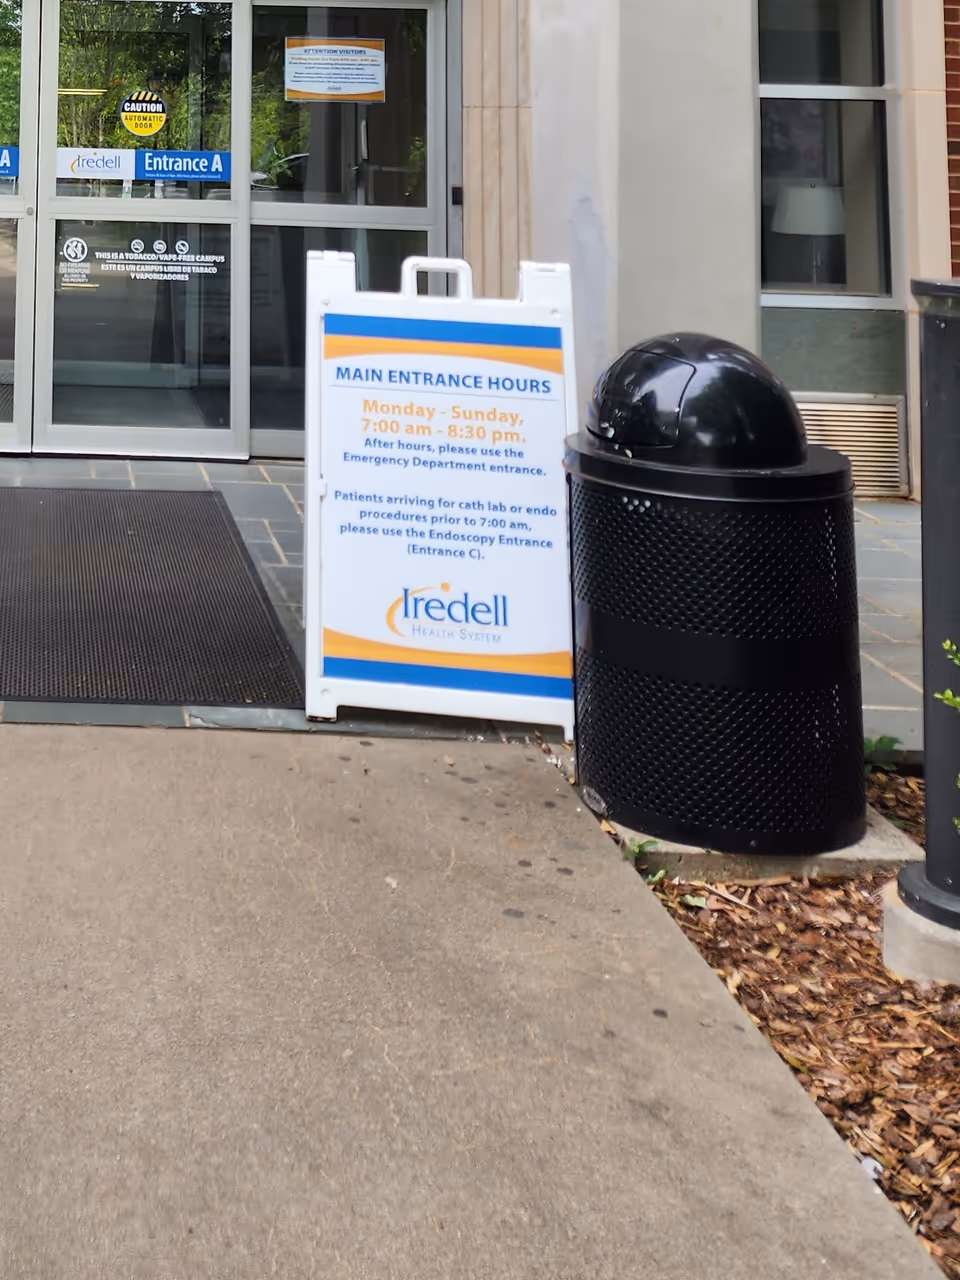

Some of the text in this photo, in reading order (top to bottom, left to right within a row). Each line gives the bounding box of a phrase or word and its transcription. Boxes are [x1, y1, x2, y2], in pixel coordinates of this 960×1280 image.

[124, 102, 163, 112] CAUTION
[0, 149, 11, 168] A
[77, 154, 121, 169] Iredell
[144, 152, 223, 172] Entrance A
[94, 251, 110, 259] THIS
[111, 252, 118, 260] IS
[119, 252, 125, 260] A
[195, 254, 225, 263] CAMPUS
[135, 272, 190, 281] VAPORIZADORES
[136, 264, 163, 272] CAMPUS
[163, 265, 182, 273] LIBRE
[191, 266, 218, 274] TABACO
[335, 366, 552, 394] MAIN ENTRANCE HOURS
[362, 399, 436, 422] Monday
[451, 405, 525, 427] Sunday,
[361, 417, 400, 434] 7:00
[404, 423, 432, 437] am
[447, 423, 487, 440] 8:30
[491, 429, 526, 445] pm.
[364, 437, 525, 459] After hours, please use the
[343, 451, 547, 477] Emergency Department entrance.
[334, 489, 557, 517] Patients arriving for cath lab or endo
[359, 509, 532, 532] procedures prior to 7:00 am,
[339, 522, 553, 549] please use the Endoscopy Entrance
[407, 543, 485, 561] (Entrance C).
[402, 586, 509, 627] Iredell
[412, 624, 502, 643] HEALTH SYSTEM
